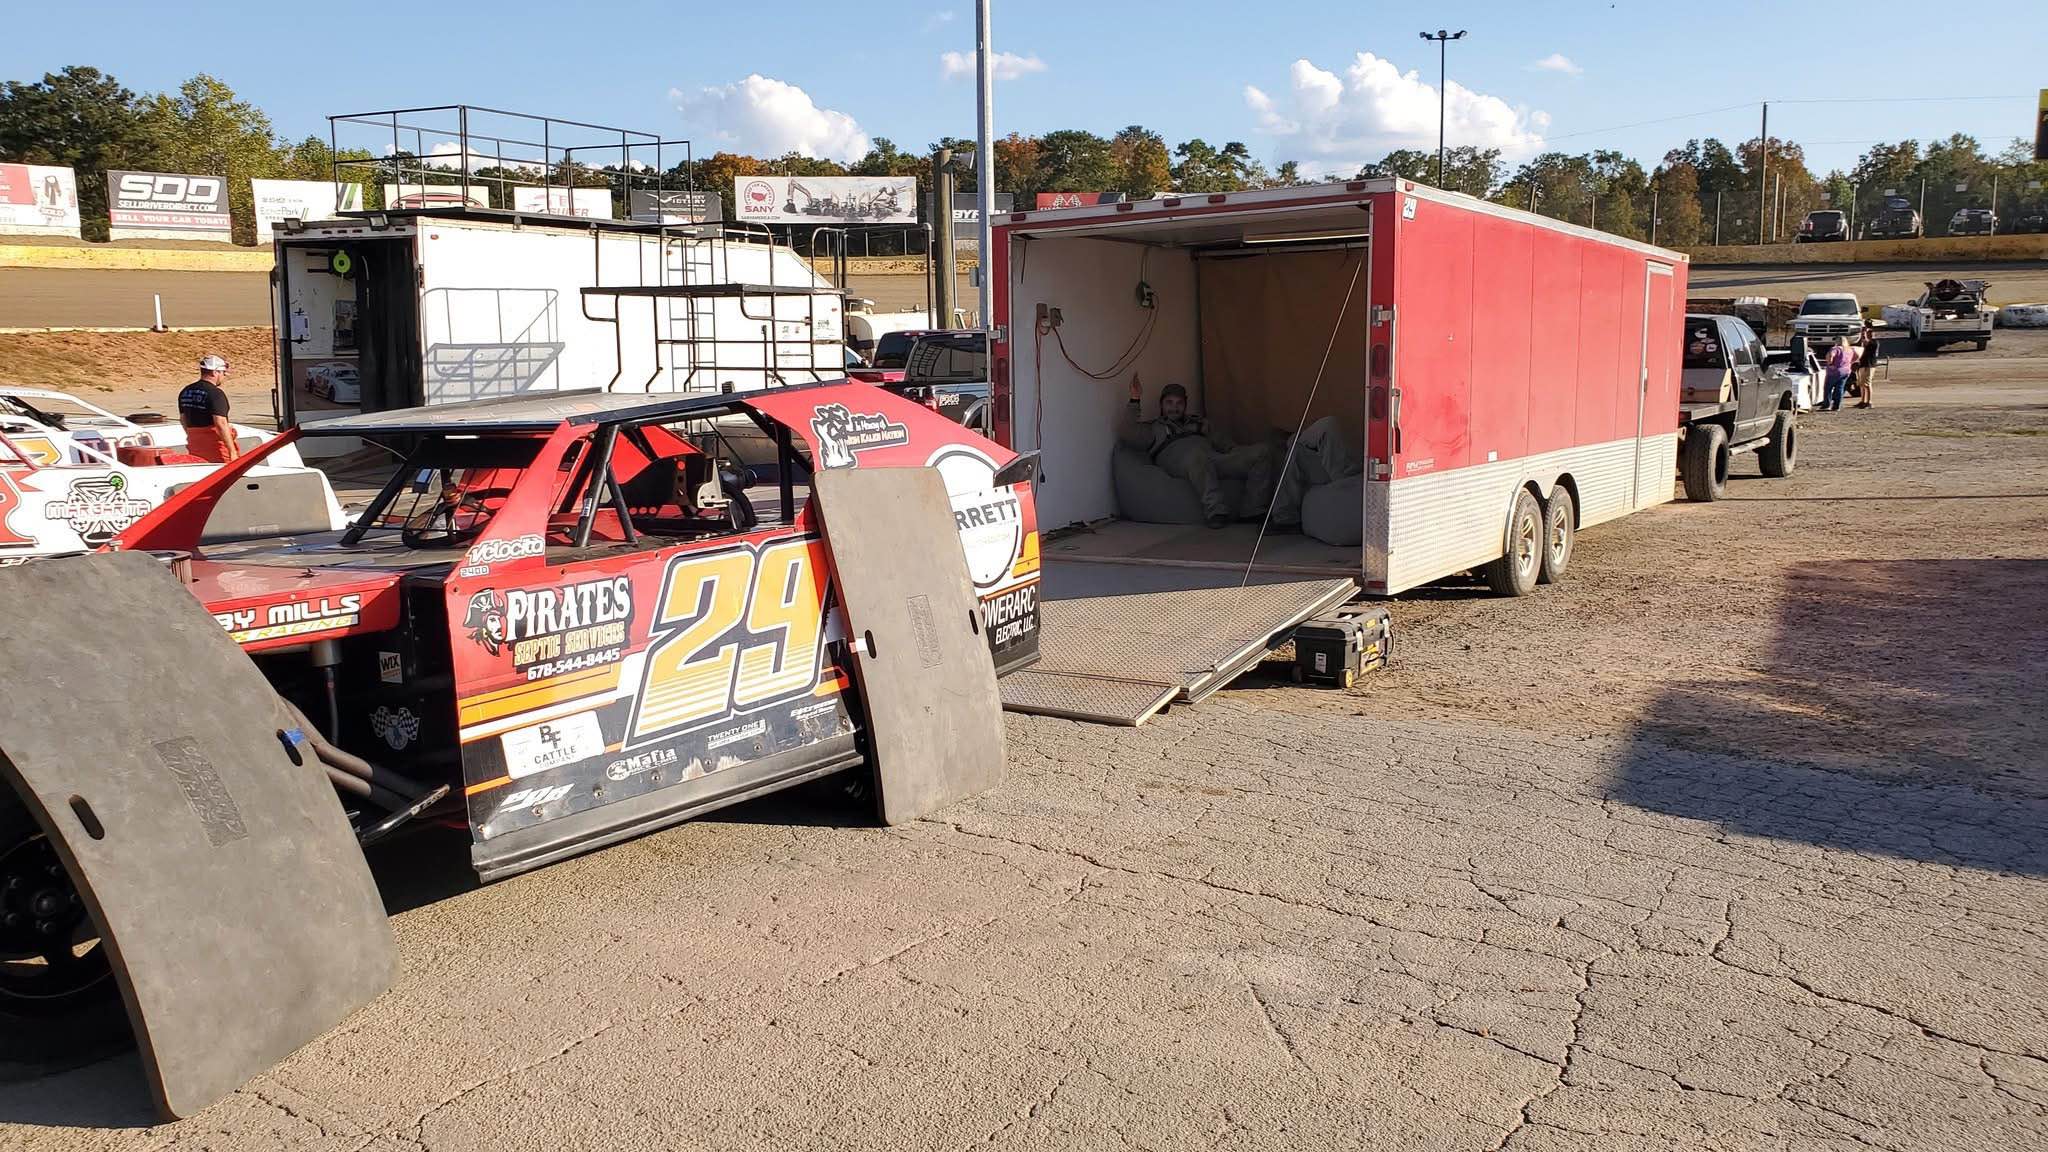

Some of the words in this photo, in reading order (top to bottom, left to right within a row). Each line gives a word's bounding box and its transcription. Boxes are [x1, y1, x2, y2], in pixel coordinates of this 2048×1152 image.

[118, 174, 220, 203] SDD
[268, 594, 361, 626] MILLS
[505, 577, 631, 641] PIRATES
[256, 616, 353, 638] RACING
[629, 538, 822, 740] 29
[514, 633, 561, 666] SEPTIC
[564, 621, 625, 654] SERVICES
[382, 655, 400, 669] WIX
[527, 647, 621, 681] 678-544-8445
[707, 727, 741, 742] TWENTY
[741, 721, 760, 731] ONE
[534, 745, 577, 764] CATTLE
[626, 748, 677, 771] Mafia
